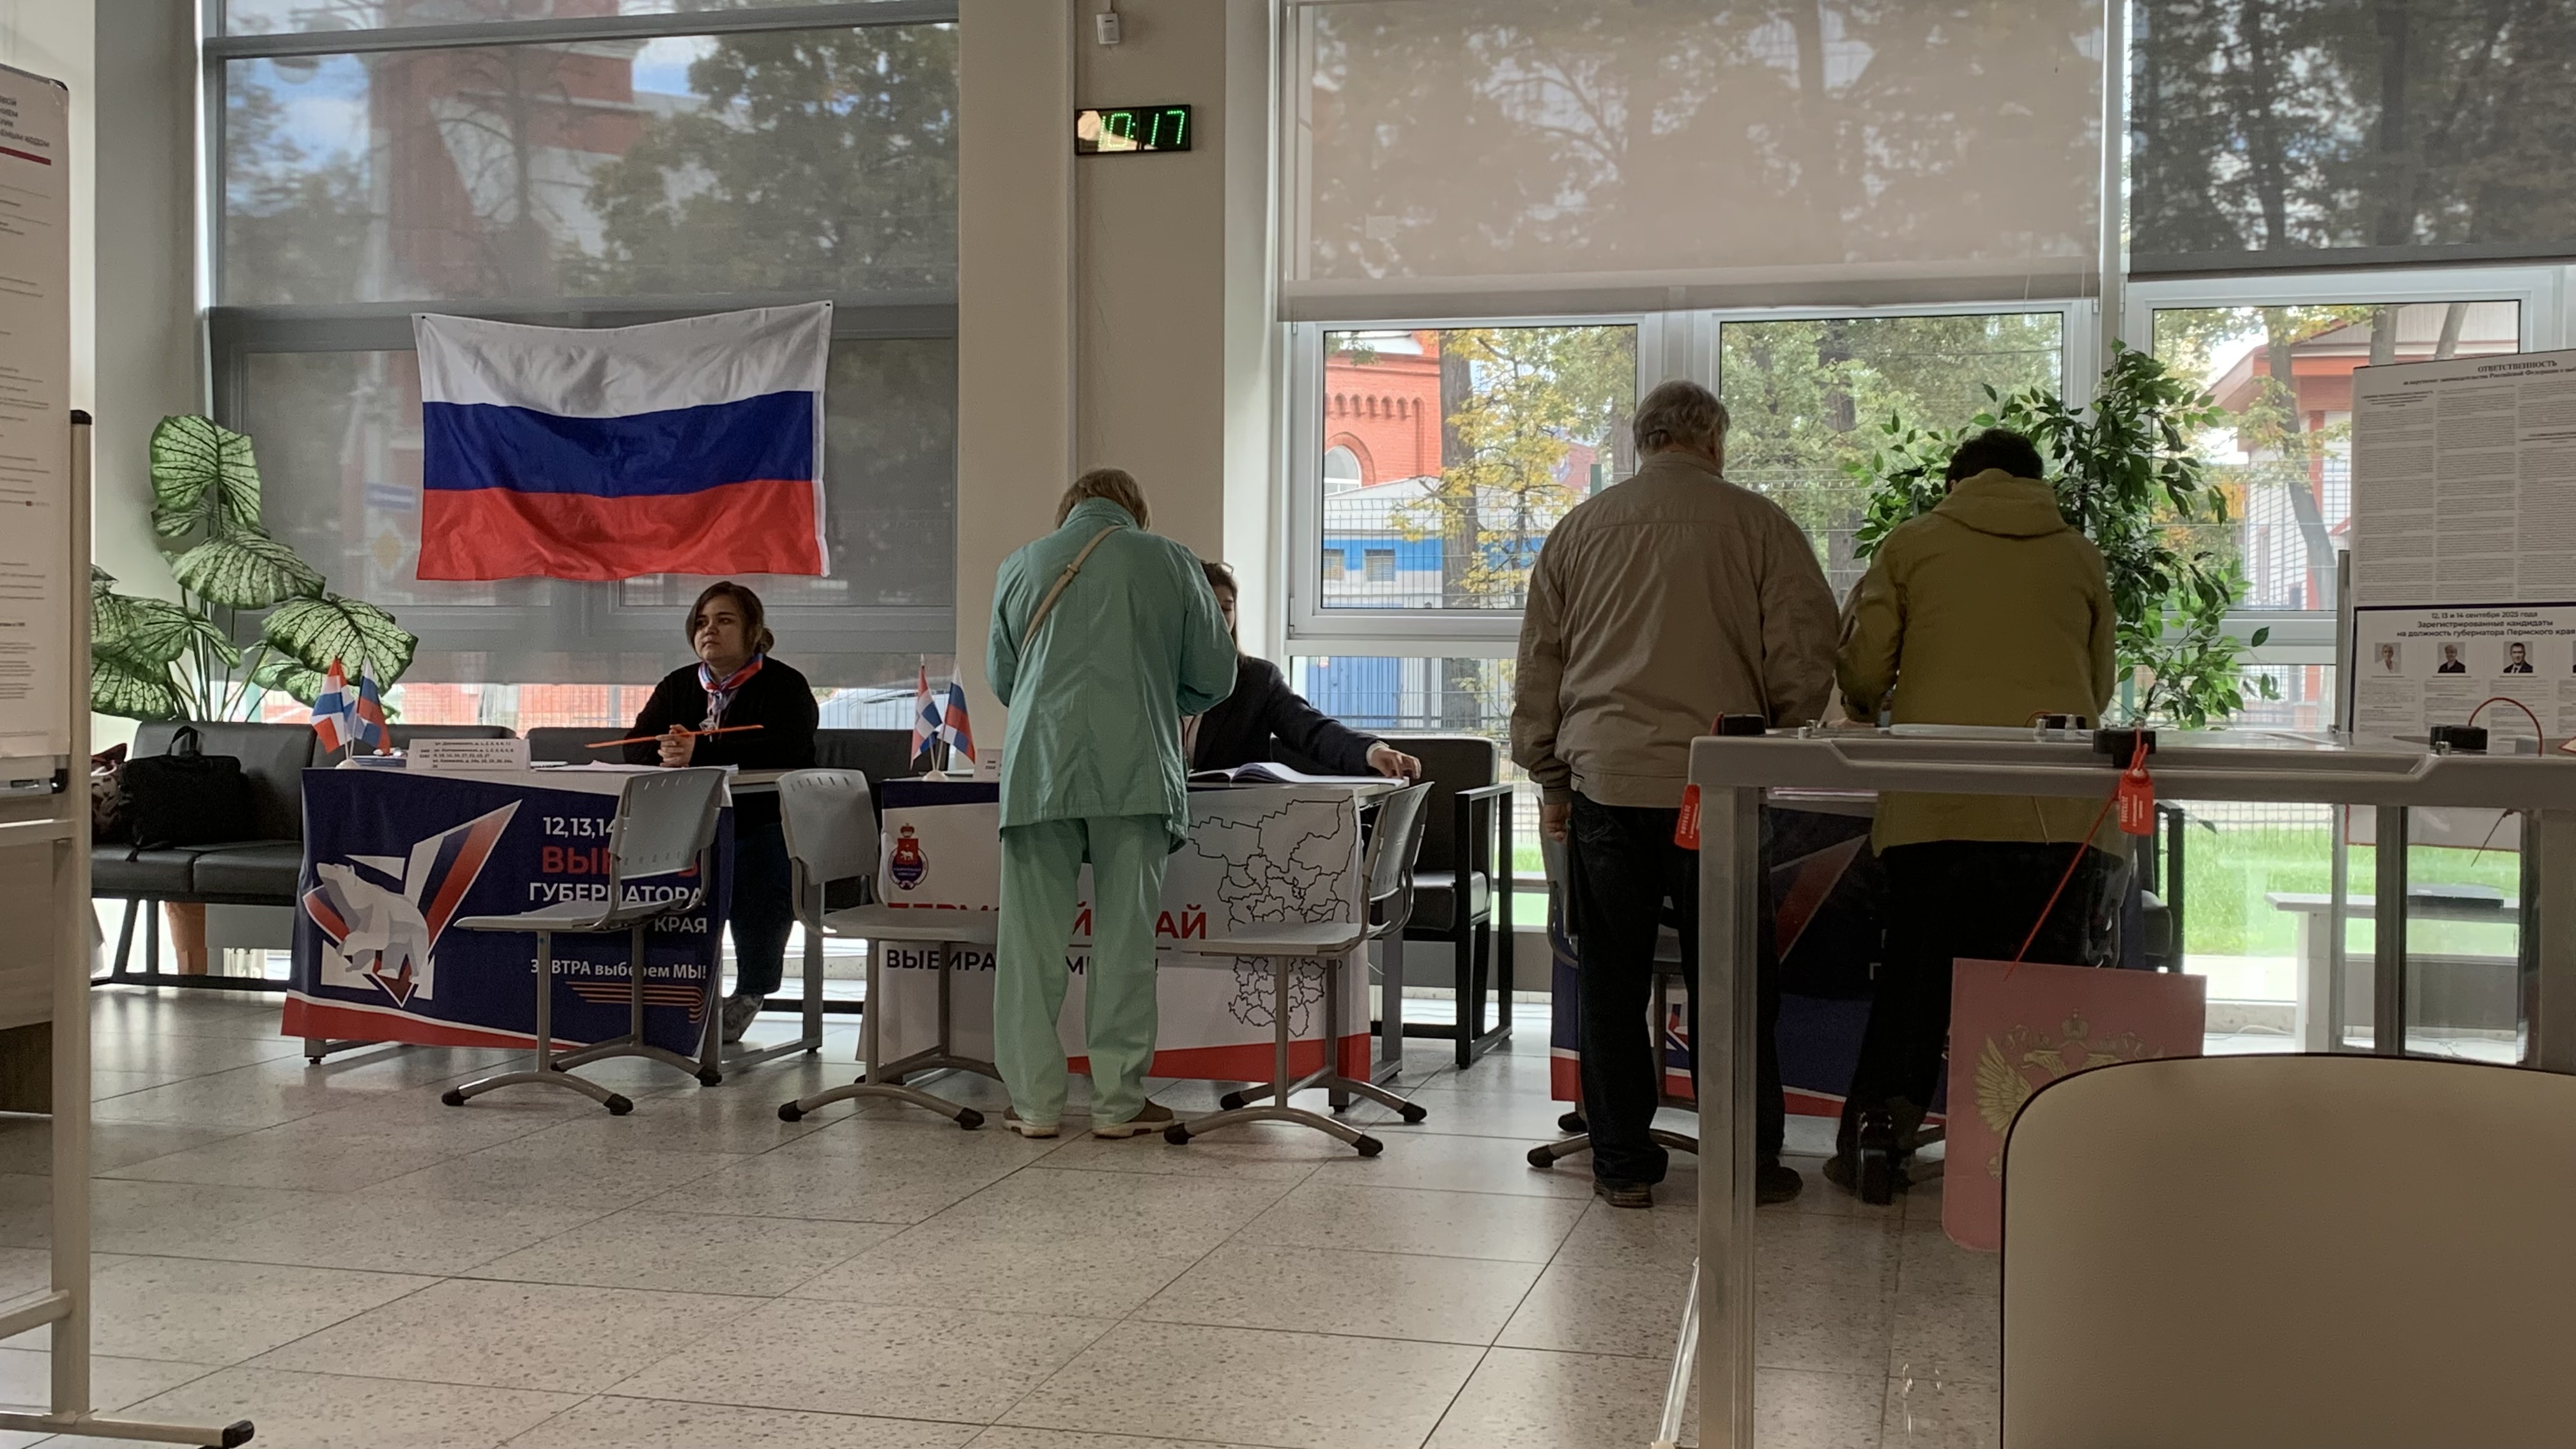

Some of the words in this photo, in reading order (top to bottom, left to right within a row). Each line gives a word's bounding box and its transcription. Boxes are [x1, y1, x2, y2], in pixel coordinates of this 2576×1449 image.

[1098, 110, 1186, 149] 10:17
[2478, 360, 2557, 372] ОТВЕТСТВЕННОСТЬ
[2418, 620, 2504, 629] Зарегистрированные
[2453, 629, 2504, 638] губернатора
[655, 916, 707, 933] КРАЯ
[530, 959, 591, 975] ЗВТРА
[673, 964, 707, 979] МЫ!
